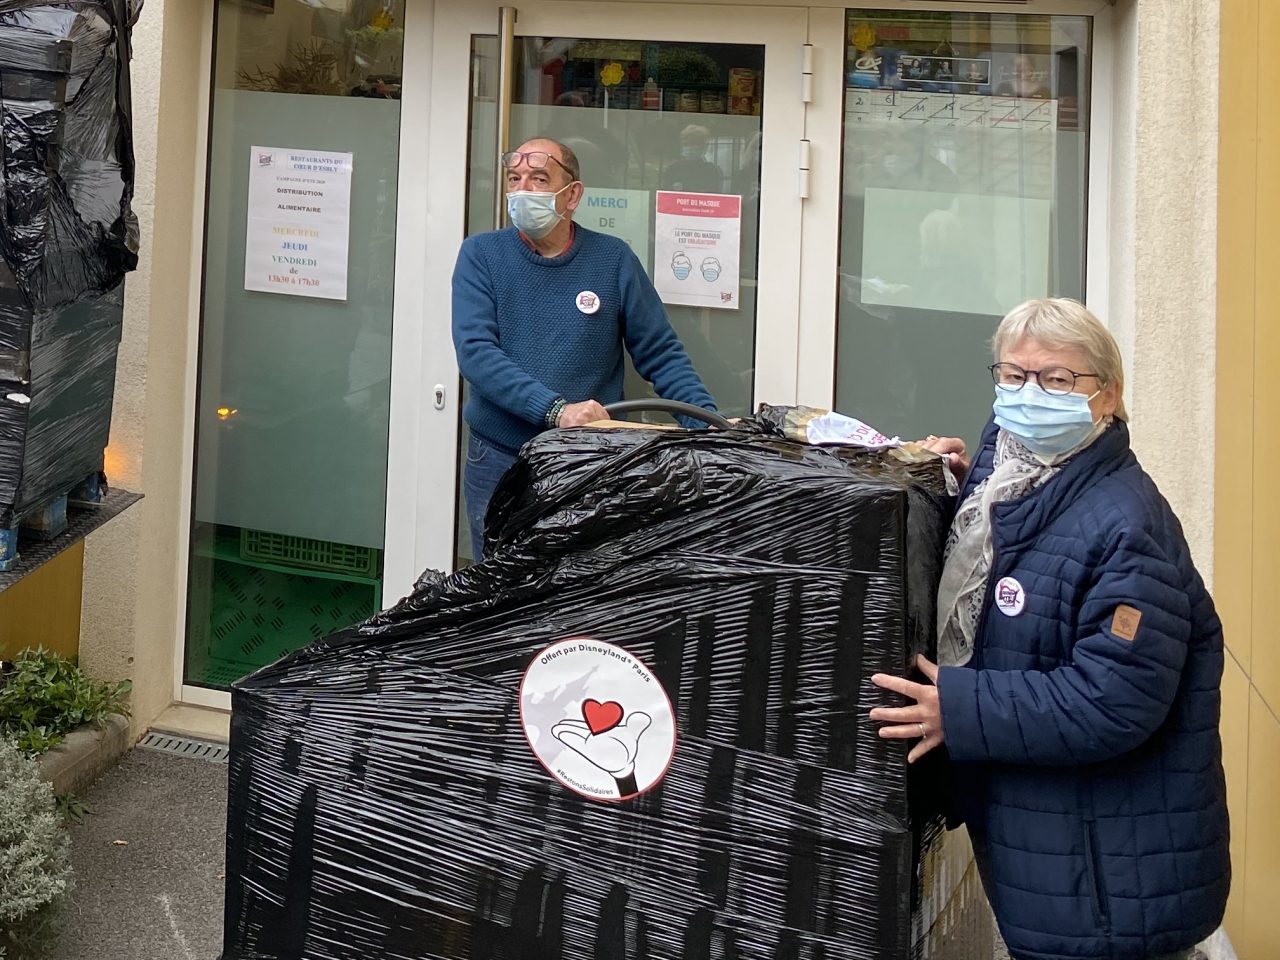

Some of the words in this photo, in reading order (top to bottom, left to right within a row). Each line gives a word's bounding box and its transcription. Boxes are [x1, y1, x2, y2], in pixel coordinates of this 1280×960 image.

[290, 155, 333, 164] RESTAURANTS
[276, 187, 324, 197] DISTRIBUTION
[587, 196, 628, 209] MERCI
[699, 200, 721, 208] MASQUE
[277, 204, 322, 213] ALIMENTAIRE
[599, 217, 615, 228] DE
[272, 226, 319, 238] MERCREDI
[282, 241, 308, 251] JEUDI
[272, 254, 317, 267] VENDREDI
[289, 267, 298, 275] de
[298, 277, 320, 287] 17h30
[540, 649, 563, 666] Offert
[564, 645, 577, 655] par
[632, 663, 651, 683] Paris
